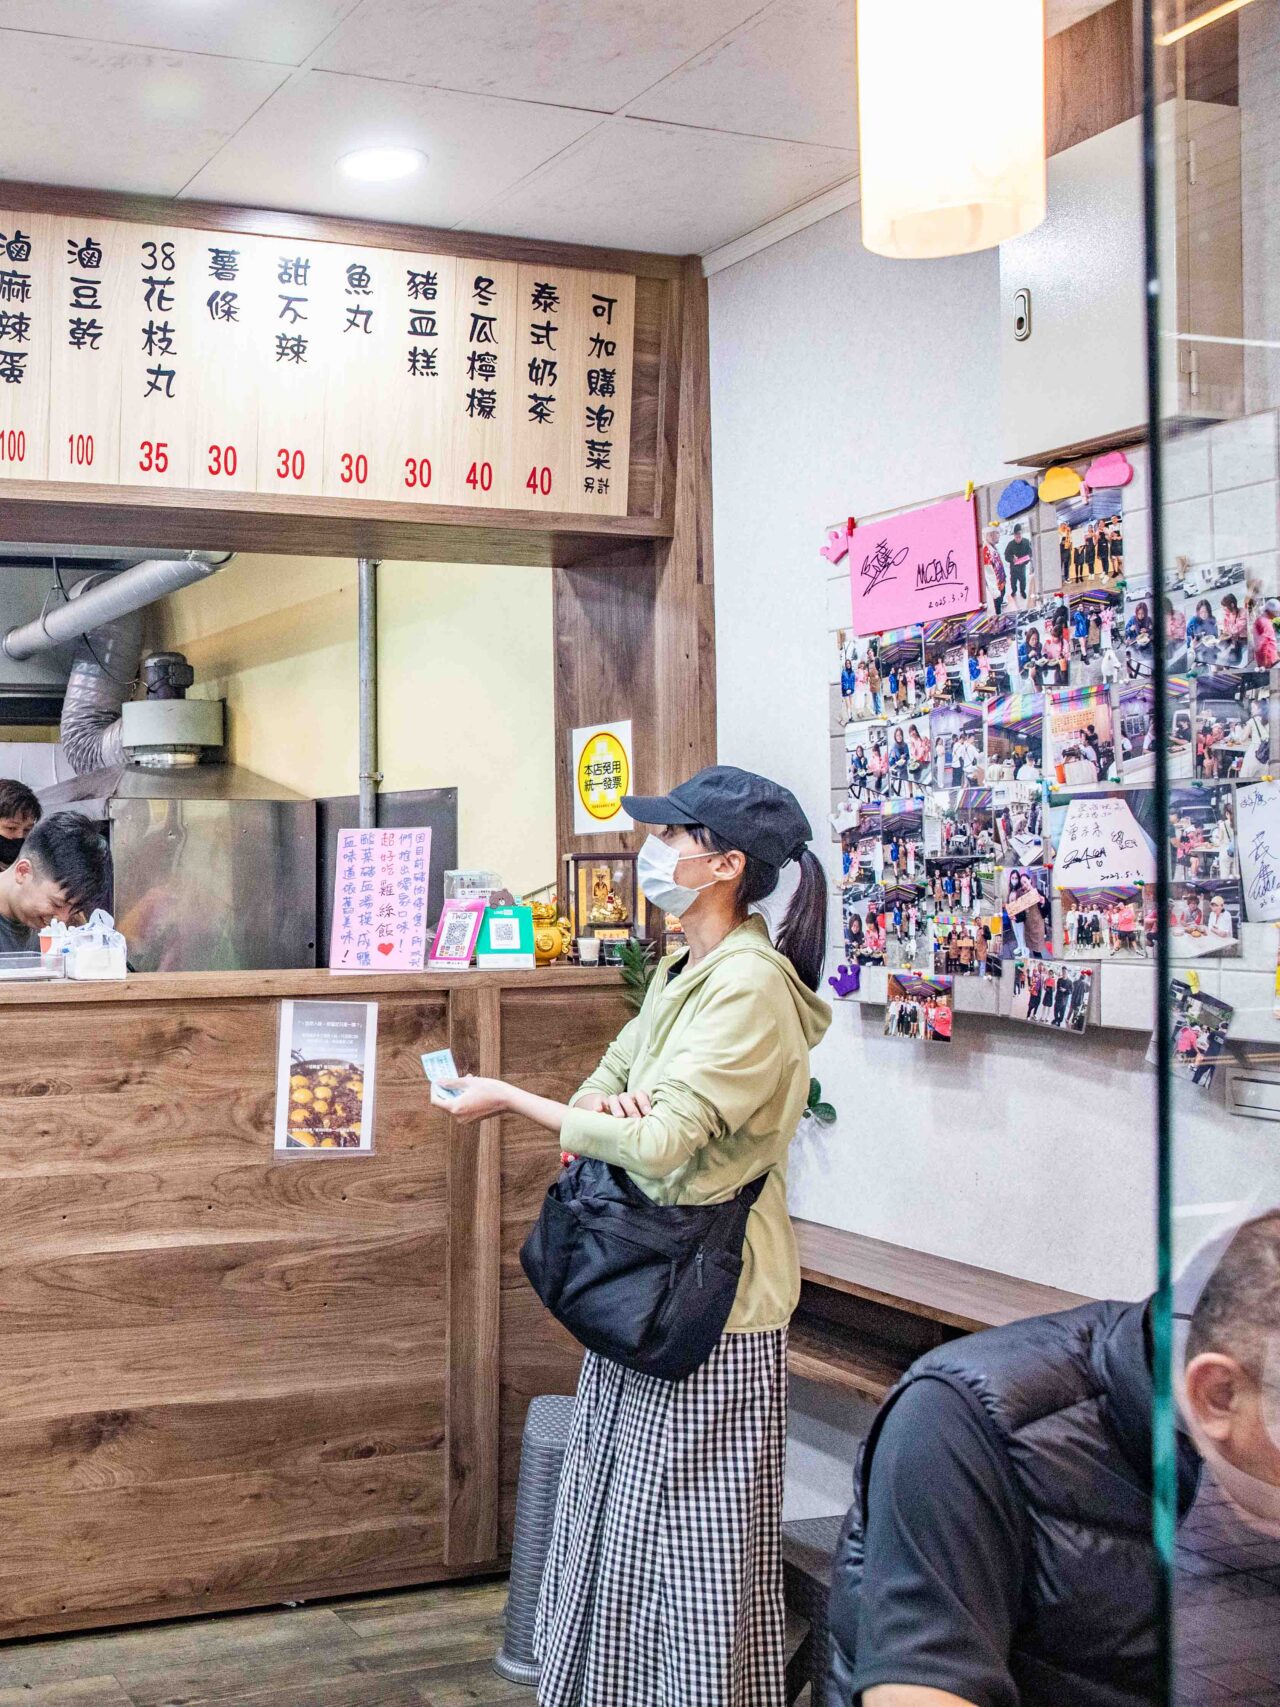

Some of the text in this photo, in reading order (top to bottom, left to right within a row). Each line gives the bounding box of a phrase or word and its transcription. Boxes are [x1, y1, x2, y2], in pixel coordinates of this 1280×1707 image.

[66, 238, 104, 352] 滷豆乾
[206, 247, 241, 322] 薯條
[343, 263, 374, 335] 魚丸
[275, 256, 311, 365] 甜不辣
[407, 270, 440, 377] 豬血糕
[466, 275, 499, 419] 冬瓜檸檬
[527, 282, 561, 424] 泰式奶茶
[585, 293, 618, 471] 可加購泡菜
[0, 430, 26, 462] 100
[68, 434, 94, 466] 100
[139, 441, 169, 473] 35
[207, 444, 238, 476] 30
[276, 449, 305, 480] 30
[340, 453, 368, 484] 30
[404, 458, 432, 488] 30
[466, 462, 493, 491] 40
[526, 466, 552, 495] 40
[584, 761, 621, 776] 本店免用
[584, 776, 622, 792] 統一發票
